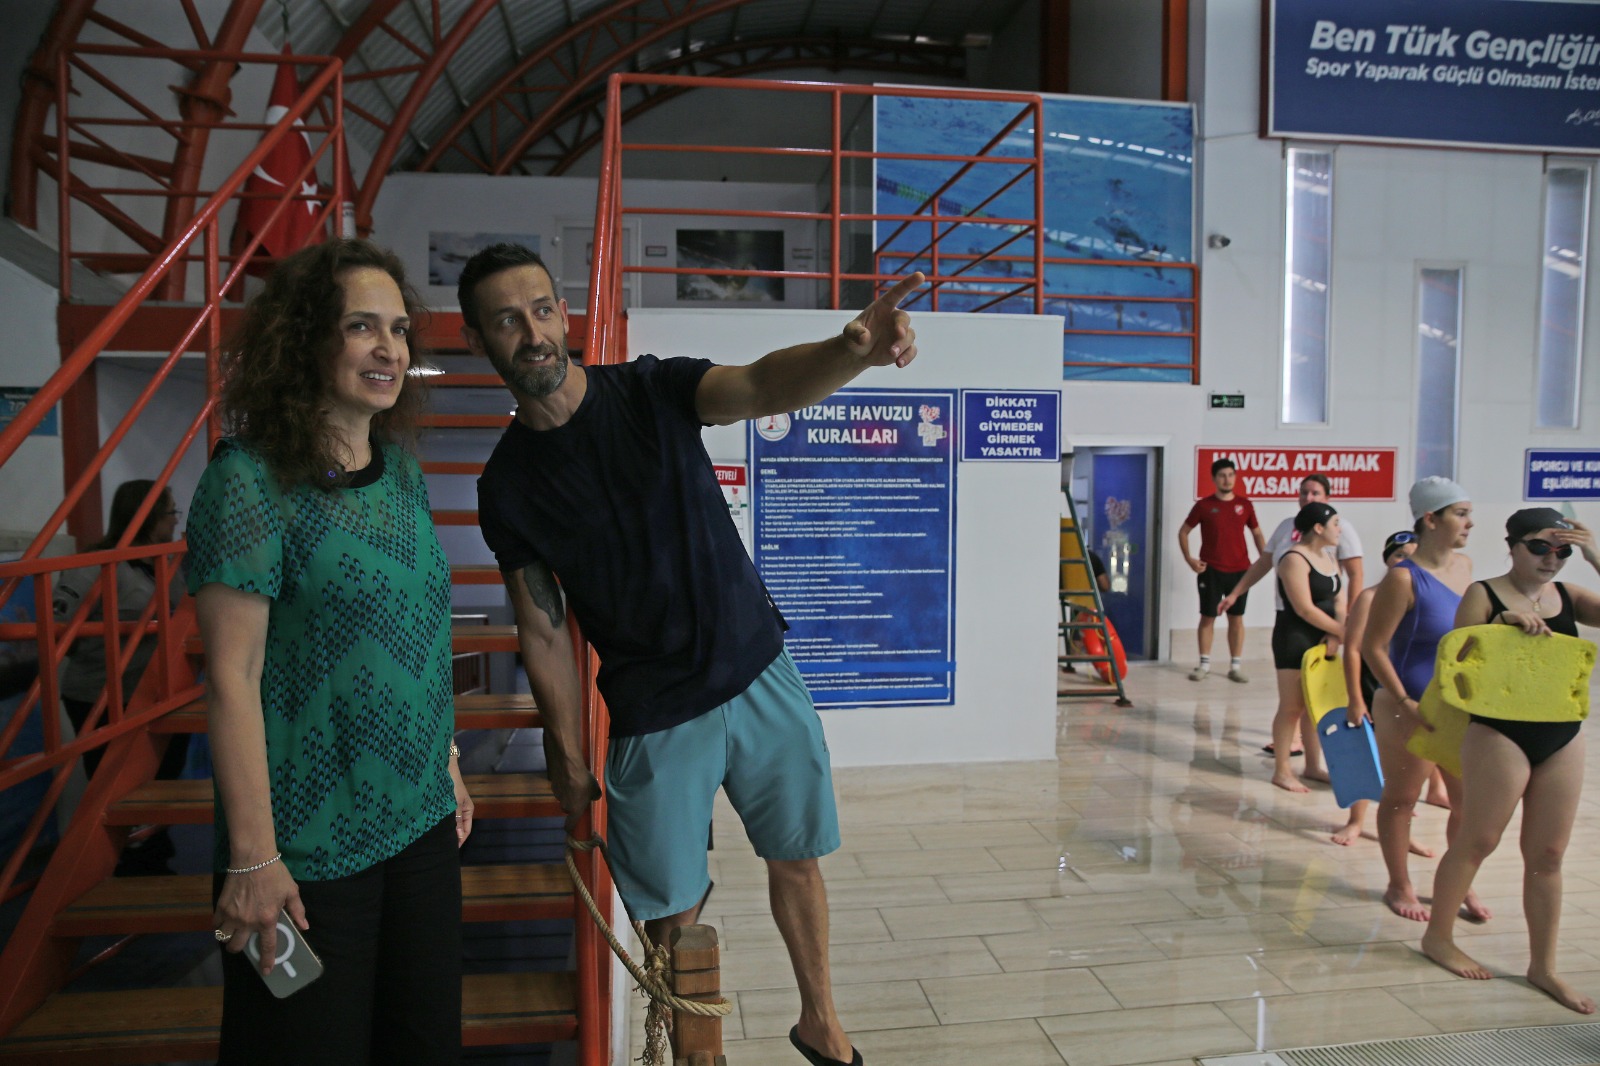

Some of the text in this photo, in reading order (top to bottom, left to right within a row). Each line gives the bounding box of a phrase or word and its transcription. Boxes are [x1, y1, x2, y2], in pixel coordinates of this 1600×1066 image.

[1309, 20, 1376, 53] Ben
[1385, 25, 1460, 57] Türk
[1305, 57, 1351, 79] Spor
[1354, 60, 1430, 82] Yaparak
[1432, 64, 1484, 87] Güçlü
[1486, 67, 1562, 90] Olmasını
[985, 396, 1037, 408] DİKKAT!
[850, 405, 913, 421] HAVUZU
[990, 410, 1032, 421] GALOŞ
[979, 420, 1044, 432] GİYMEDEN
[807, 428, 898, 444] KURALLARI
[987, 433, 1036, 444] GİRMEK
[980, 447, 1042, 457] YASAKTIR
[1292, 452, 1380, 472] ATLAMAK
